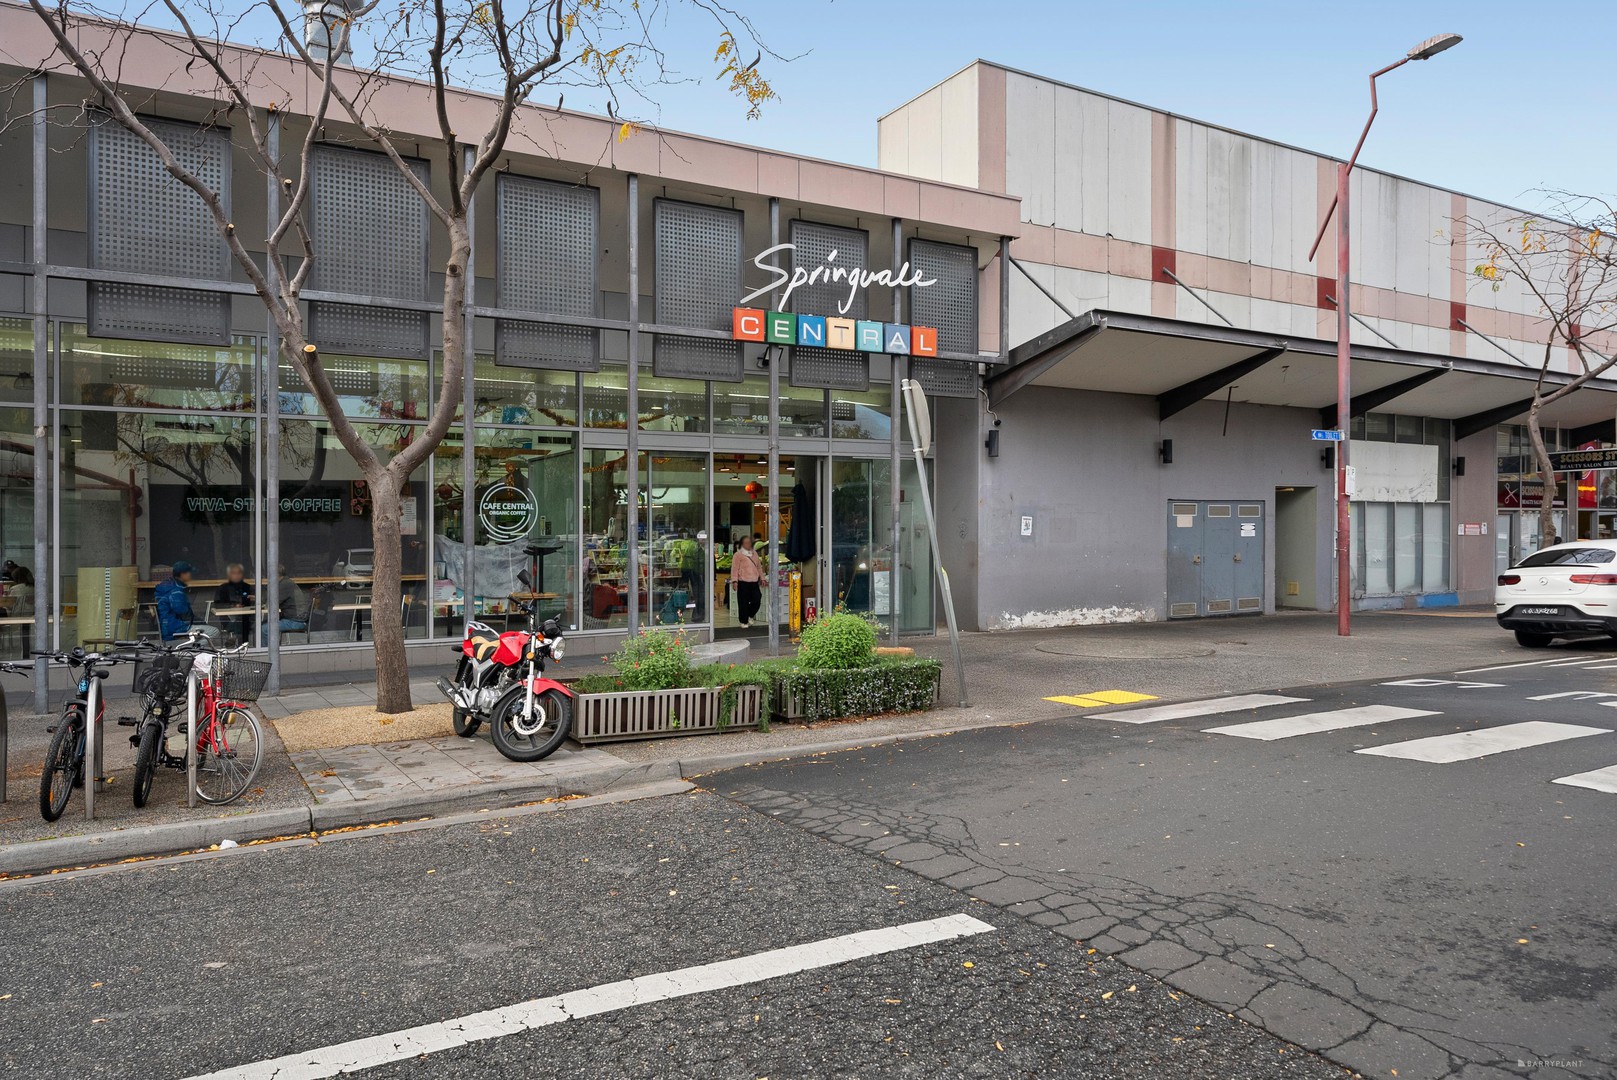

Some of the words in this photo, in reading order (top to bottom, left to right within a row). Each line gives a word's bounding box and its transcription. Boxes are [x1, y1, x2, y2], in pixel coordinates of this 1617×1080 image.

[740, 243, 938, 314] Springvale
[740, 316, 933, 352] CENTRAL
[1560, 452, 1604, 463] SCISSORS
[186, 497, 227, 512] VIVA
[280, 498, 342, 512] COFFEE
